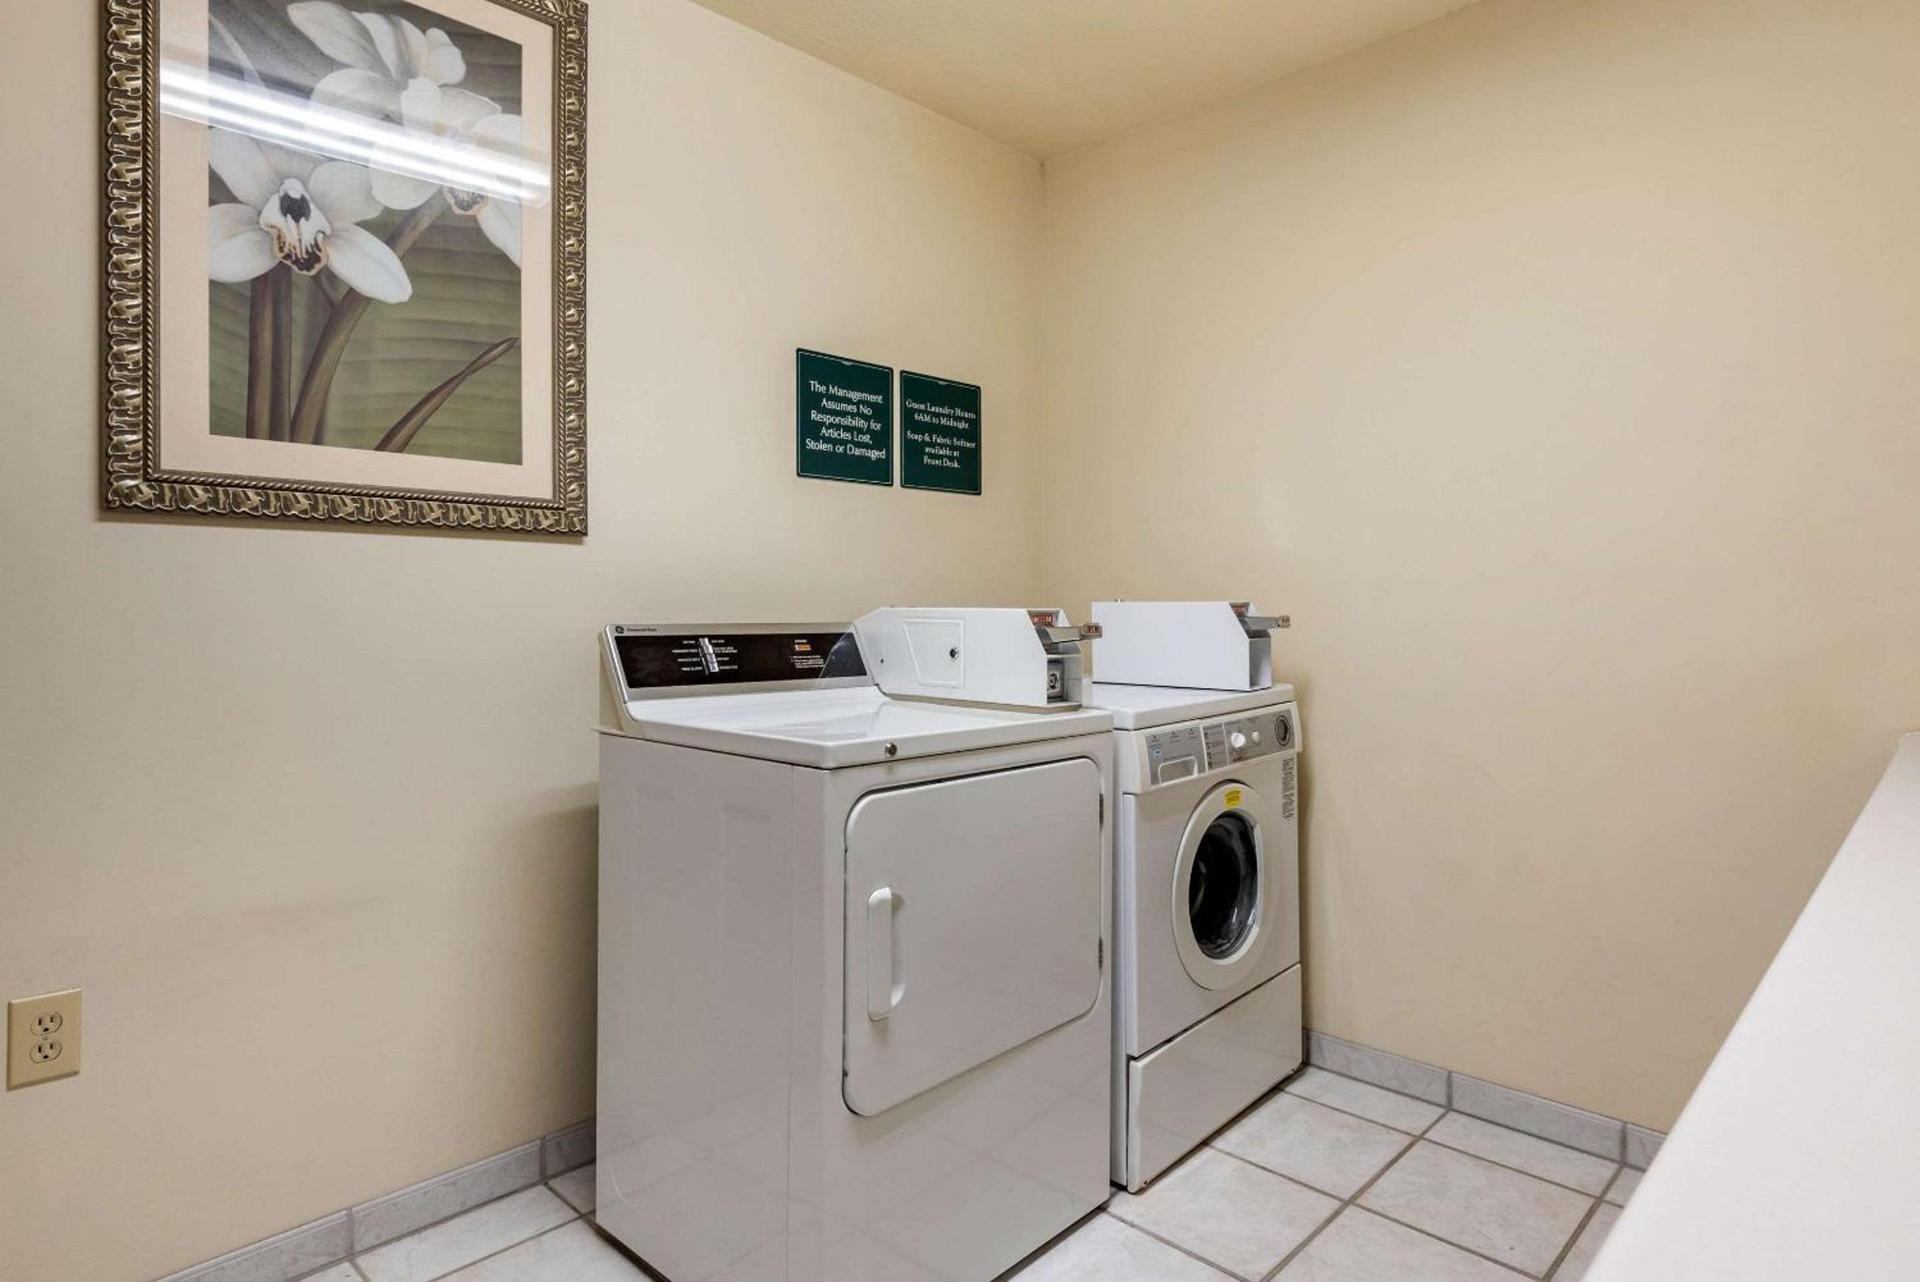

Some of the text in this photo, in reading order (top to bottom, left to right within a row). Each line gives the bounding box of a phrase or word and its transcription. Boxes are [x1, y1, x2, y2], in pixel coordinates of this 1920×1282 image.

[809, 380, 884, 404] The Management
[821, 398, 872, 416] Assumes No
[906, 399, 926, 410] Guest
[928, 402, 954, 415] Laundry
[810, 410, 882, 431] Responsibility for
[914, 413, 930, 422] 6AM
[940, 417, 969, 429] Midnight
[820, 426, 872, 444] Articles Lost,
[906, 430, 923, 442] Soap
[924, 433, 931, 442] &
[932, 435, 952, 444] Fabric
[806, 438, 886, 460] Stolen or Damaged
[925, 446, 952, 456] available
[924, 456, 942, 466] Front
